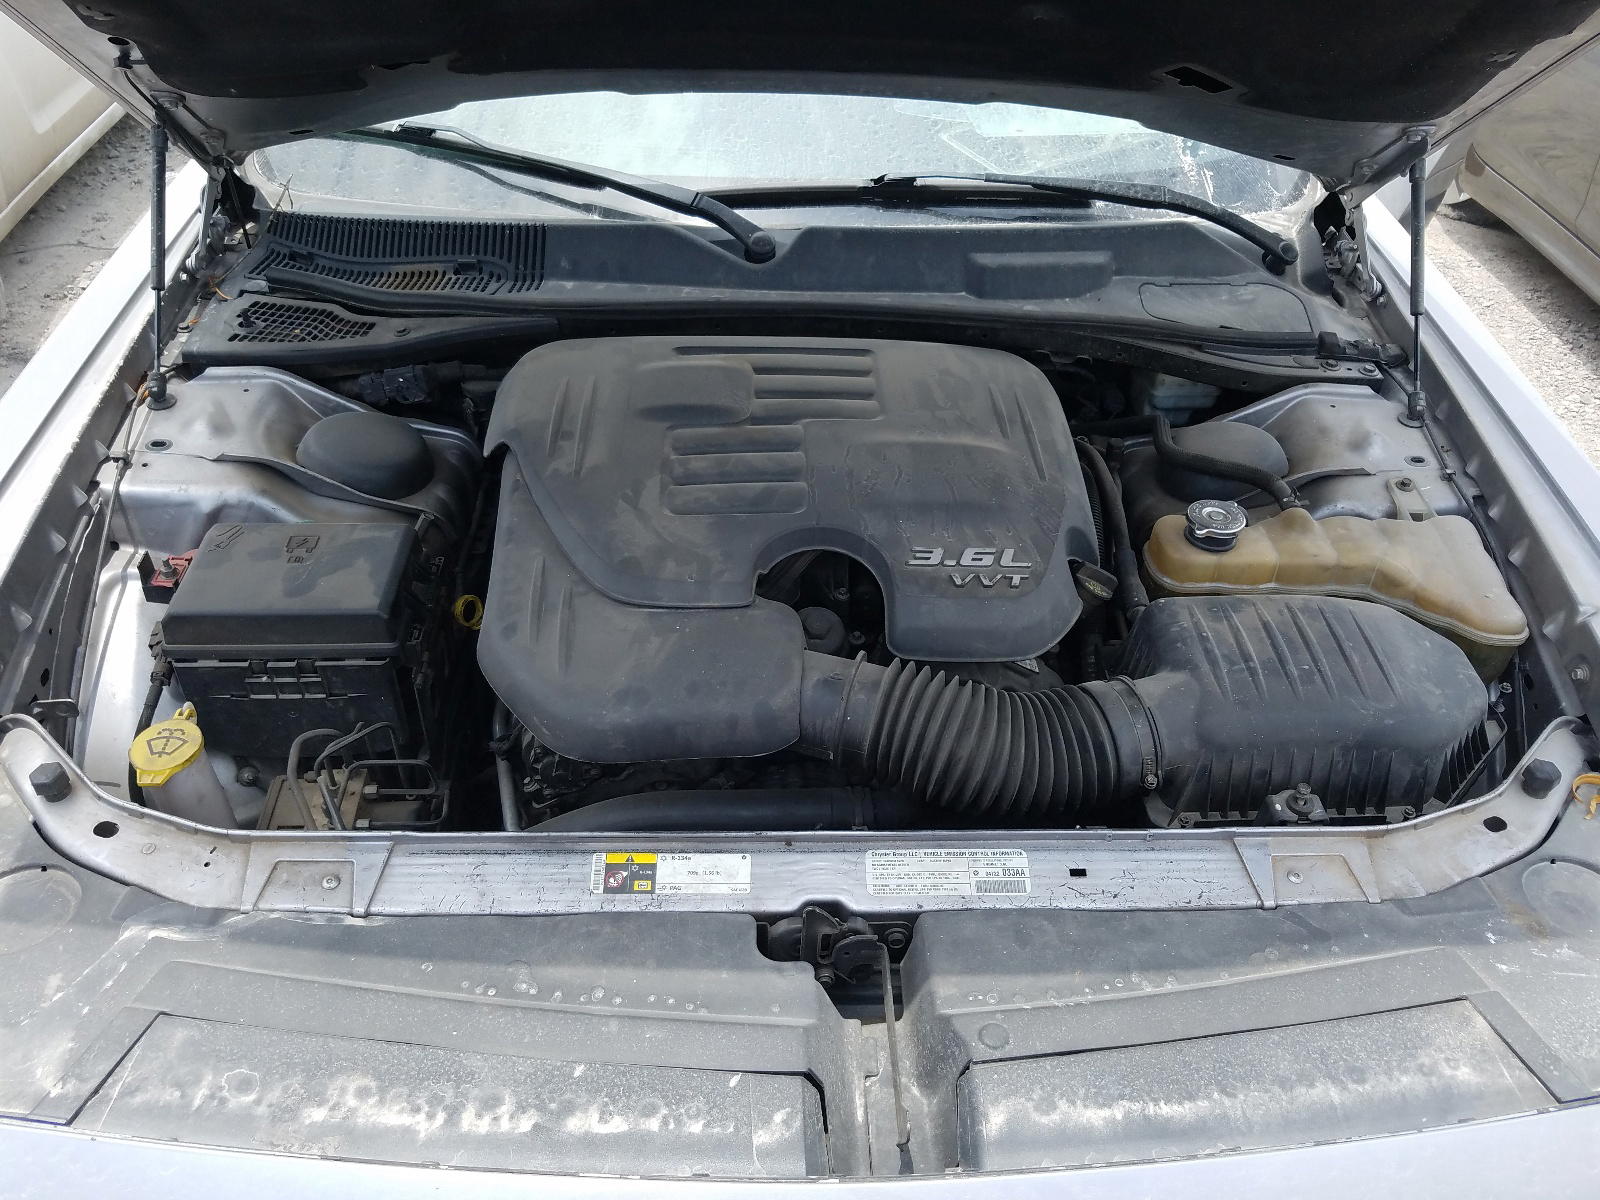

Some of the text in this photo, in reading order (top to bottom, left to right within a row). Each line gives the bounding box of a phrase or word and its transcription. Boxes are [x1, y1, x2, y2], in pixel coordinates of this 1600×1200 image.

[905, 547, 1032, 568] 3.6L
[950, 573, 1029, 589] VVT
[1002, 868, 1026, 877] 033AA
